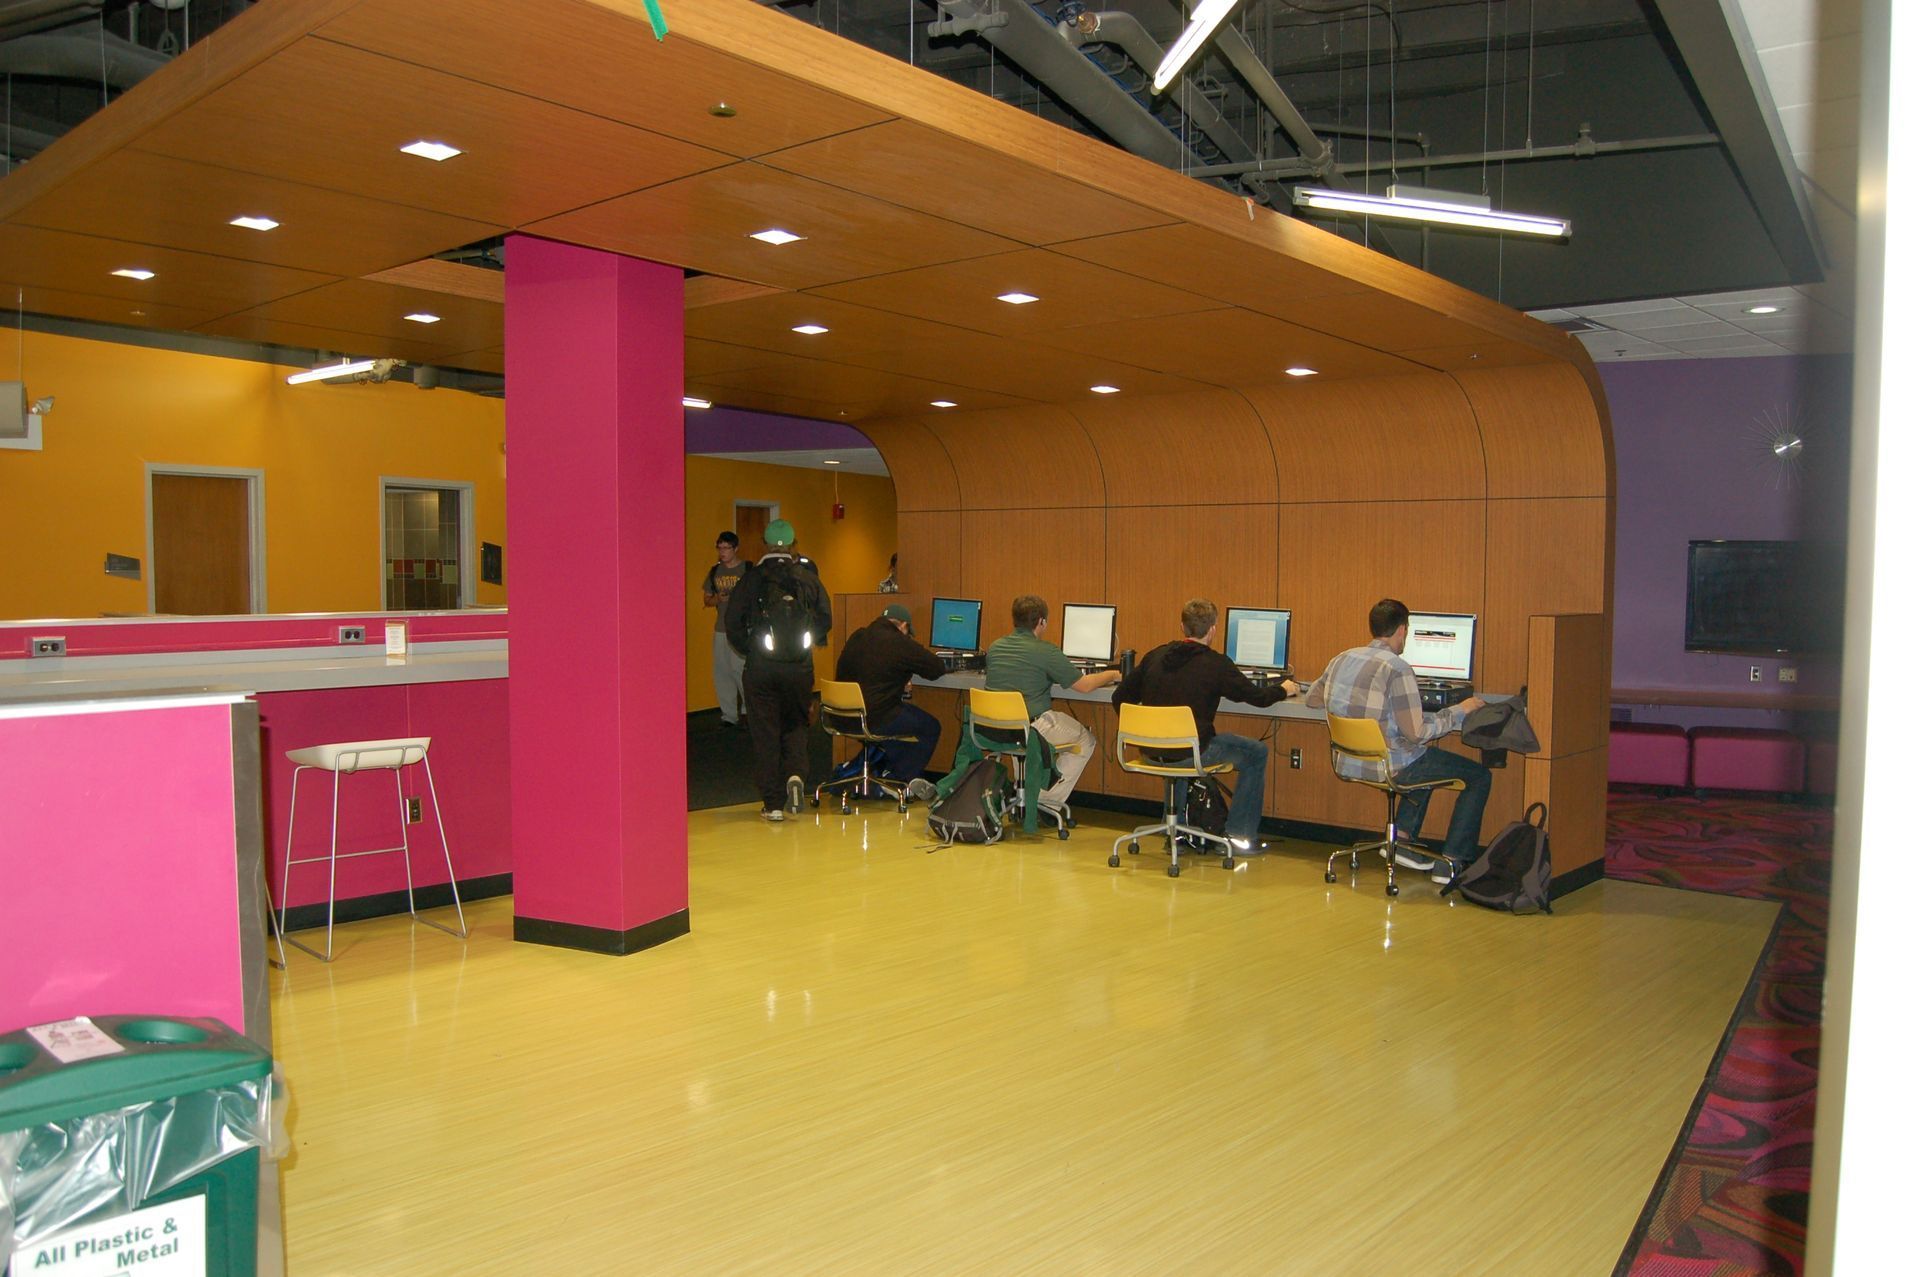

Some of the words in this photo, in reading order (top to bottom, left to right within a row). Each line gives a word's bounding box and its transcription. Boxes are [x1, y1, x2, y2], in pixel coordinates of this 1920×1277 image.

[34, 1245, 66, 1269] All
[74, 1226, 154, 1258] Plastic
[162, 1217, 178, 1235] &
[116, 1237, 179, 1268] Metal
